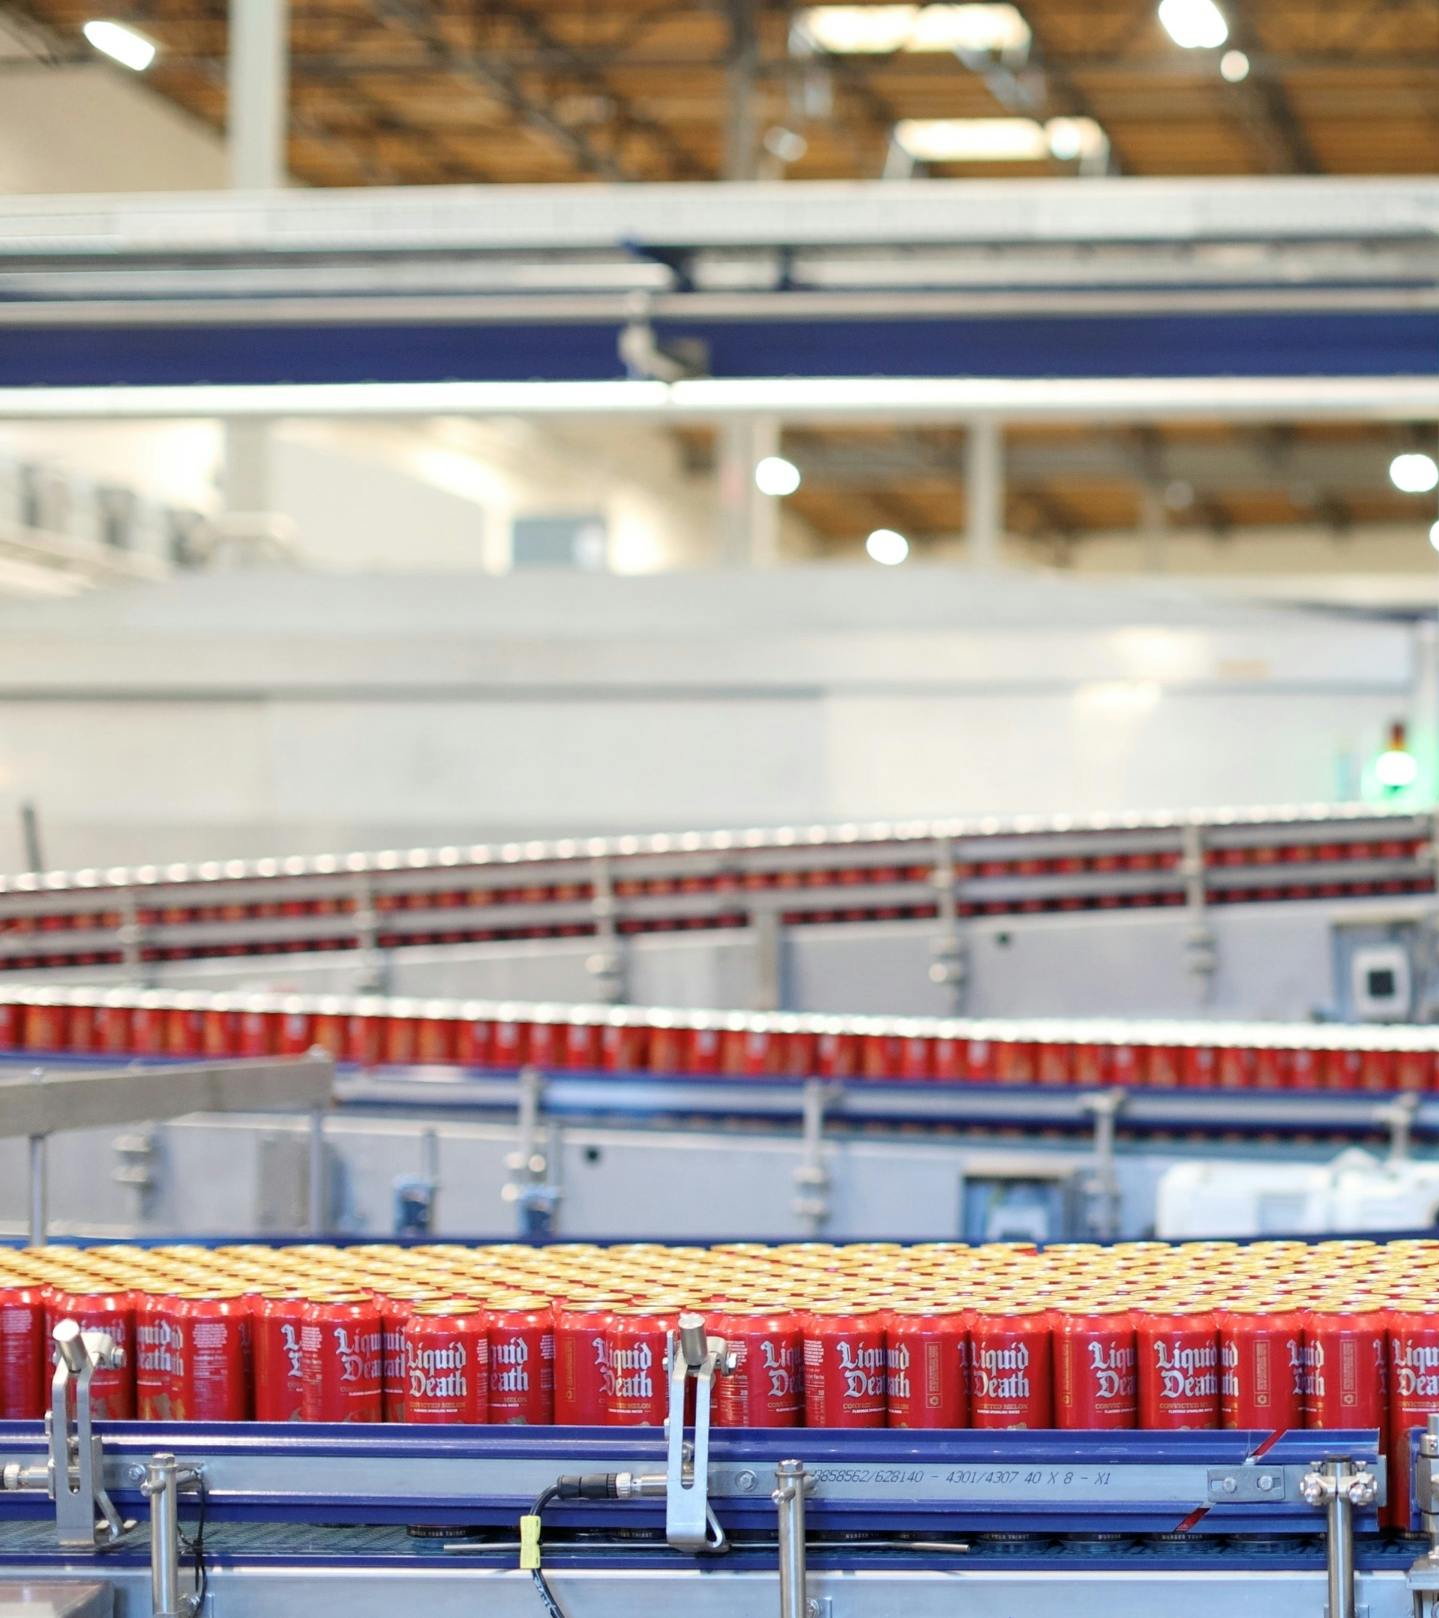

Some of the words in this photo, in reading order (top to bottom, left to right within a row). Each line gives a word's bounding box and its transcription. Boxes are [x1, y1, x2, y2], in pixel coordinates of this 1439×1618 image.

[405, 1341, 467, 1376] Liquid
[490, 1337, 529, 1371] quid
[966, 1341, 1029, 1377] Liquid
[1088, 1341, 1136, 1374] Liqu
[1154, 1340, 1218, 1376] Liquid
[409, 1370, 467, 1397] Death
[490, 1365, 529, 1392] eath
[843, 1369, 885, 1398] Dea
[974, 1371, 1030, 1398] Death
[1096, 1370, 1136, 1398] Dea
[946, 1470, 1020, 1484] 4301/4307
[1025, 1471, 1042, 1484] 40
[1049, 1471, 1057, 1484] X
[1063, 1472, 1073, 1484] 8
